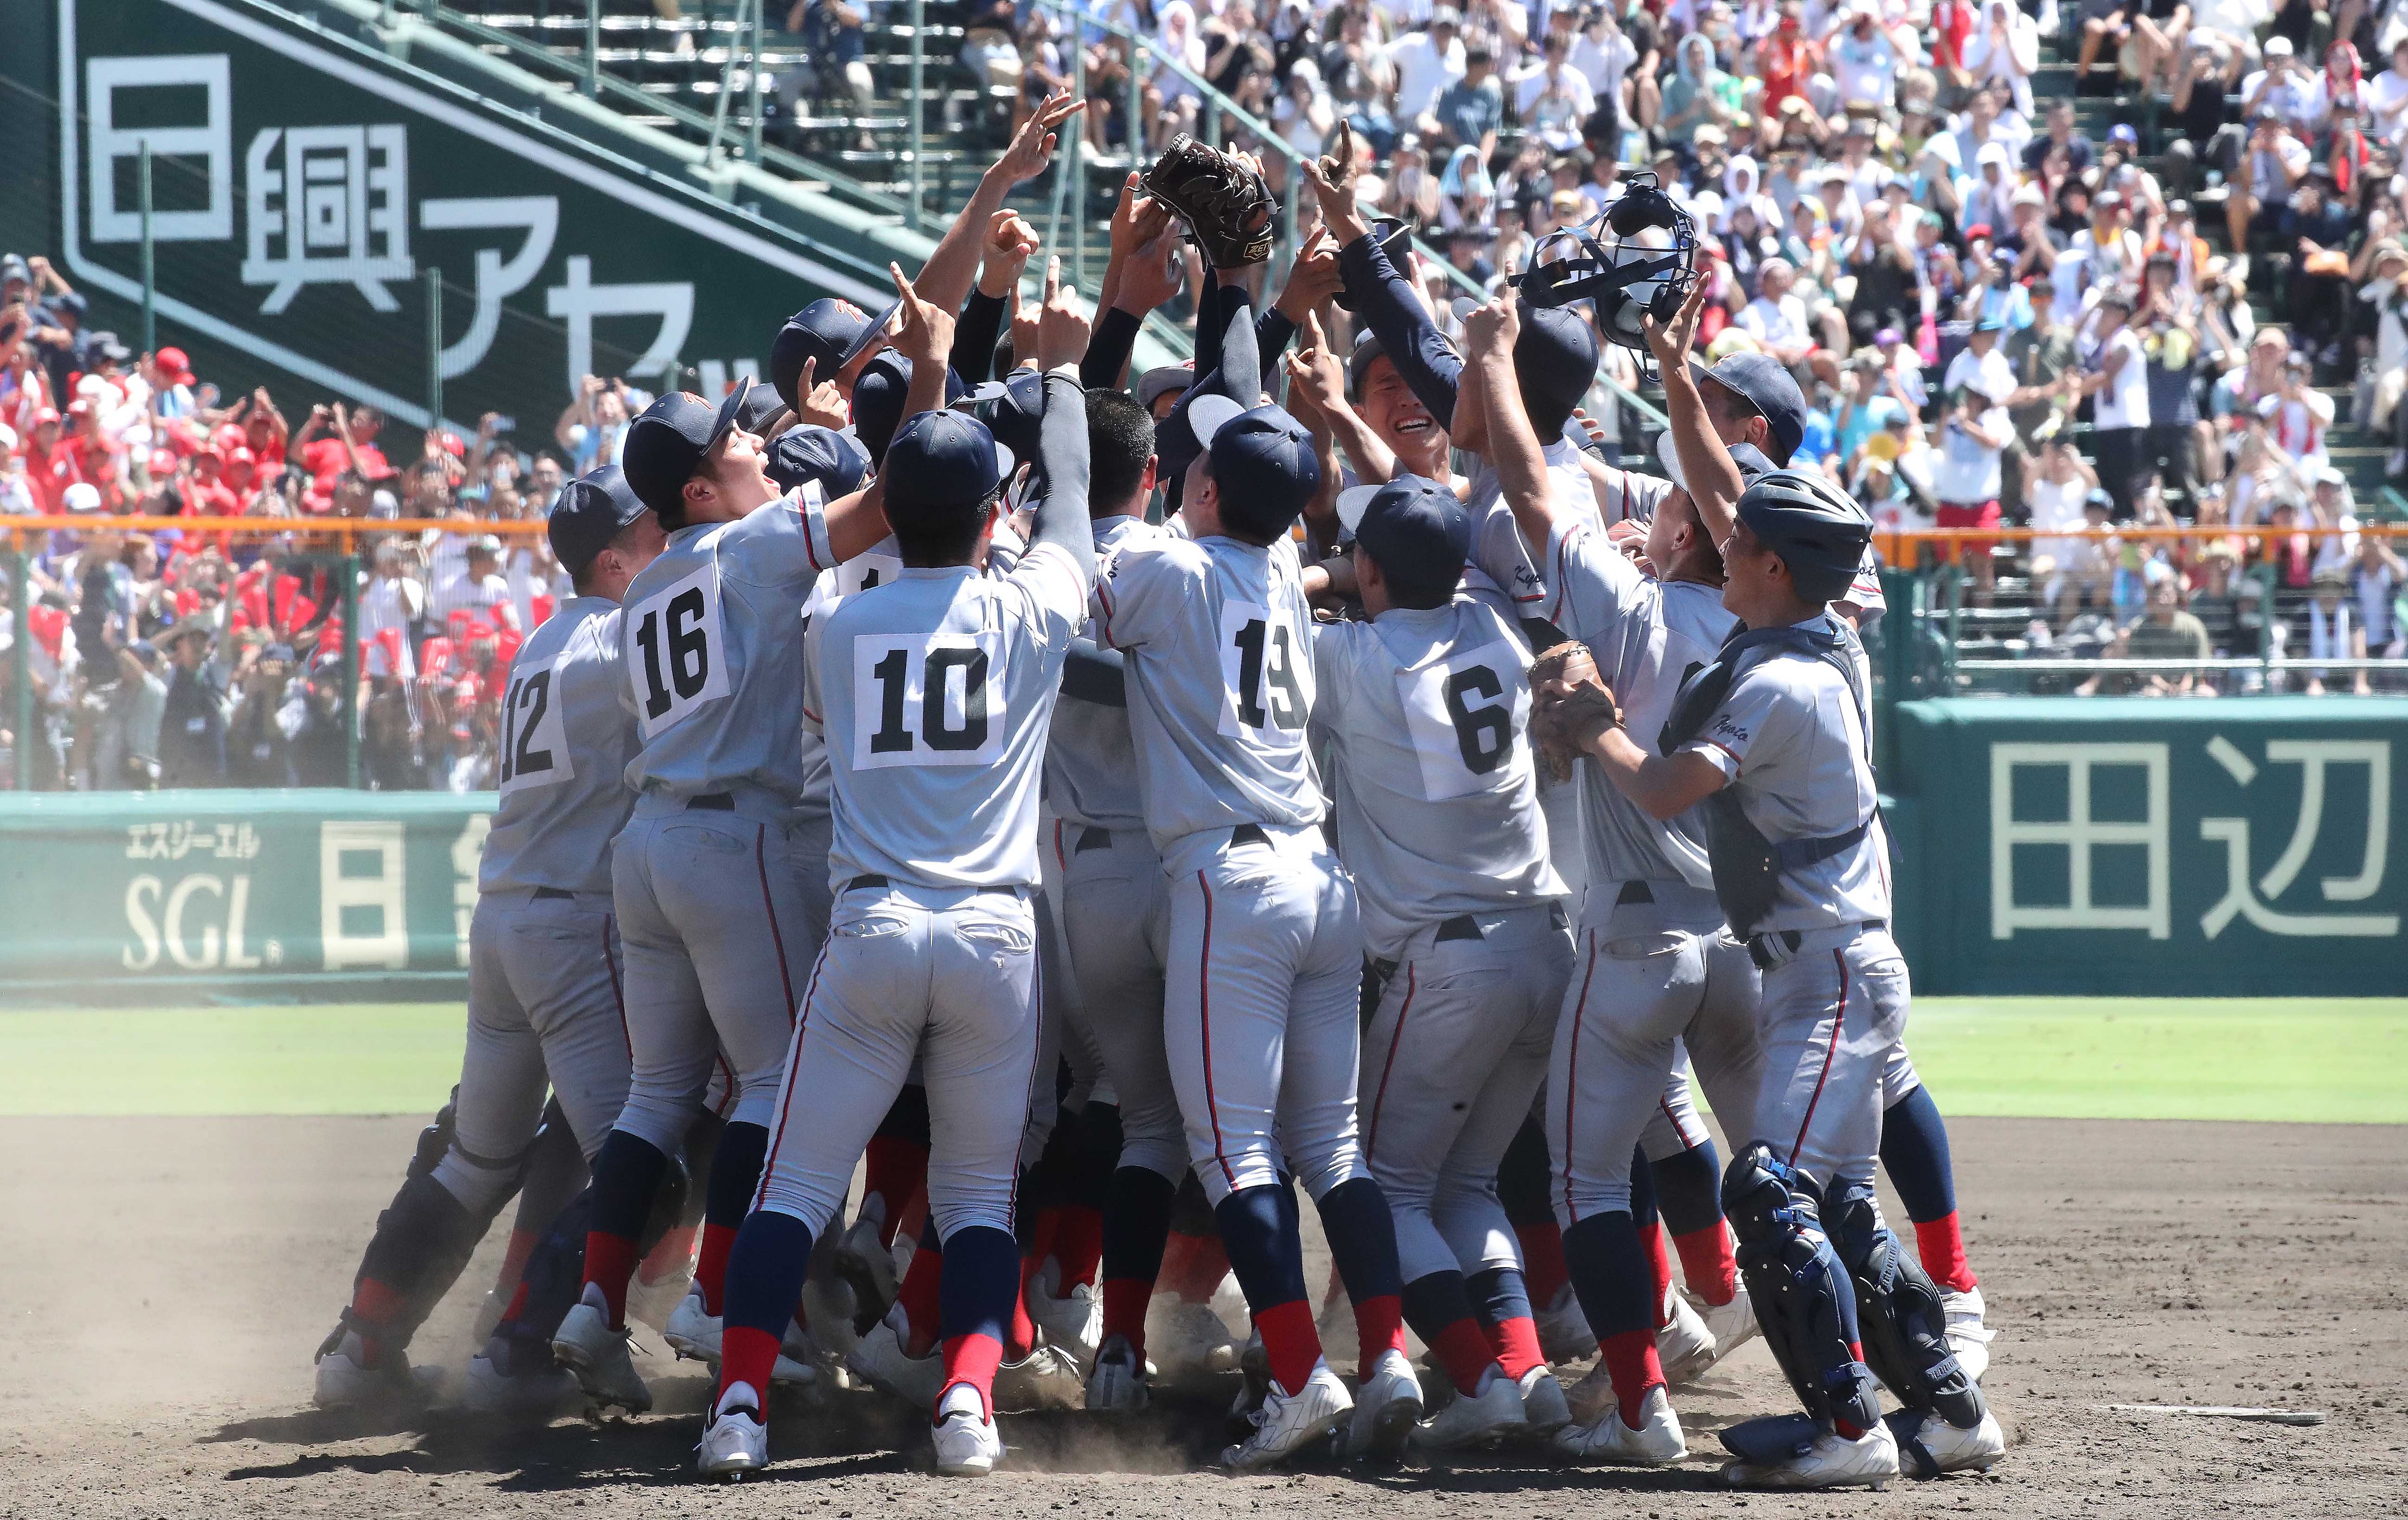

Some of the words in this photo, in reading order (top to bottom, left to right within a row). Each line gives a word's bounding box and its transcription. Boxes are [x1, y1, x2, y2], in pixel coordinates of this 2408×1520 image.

[636, 586, 708, 720] 16
[871, 648, 989, 754] 10
[1234, 618, 1309, 730] 19
[502, 669, 553, 783] 12
[1440, 664, 1515, 776] 6
[126, 820, 261, 860] エスジーエル
[1990, 734, 2400, 940] 田辺
